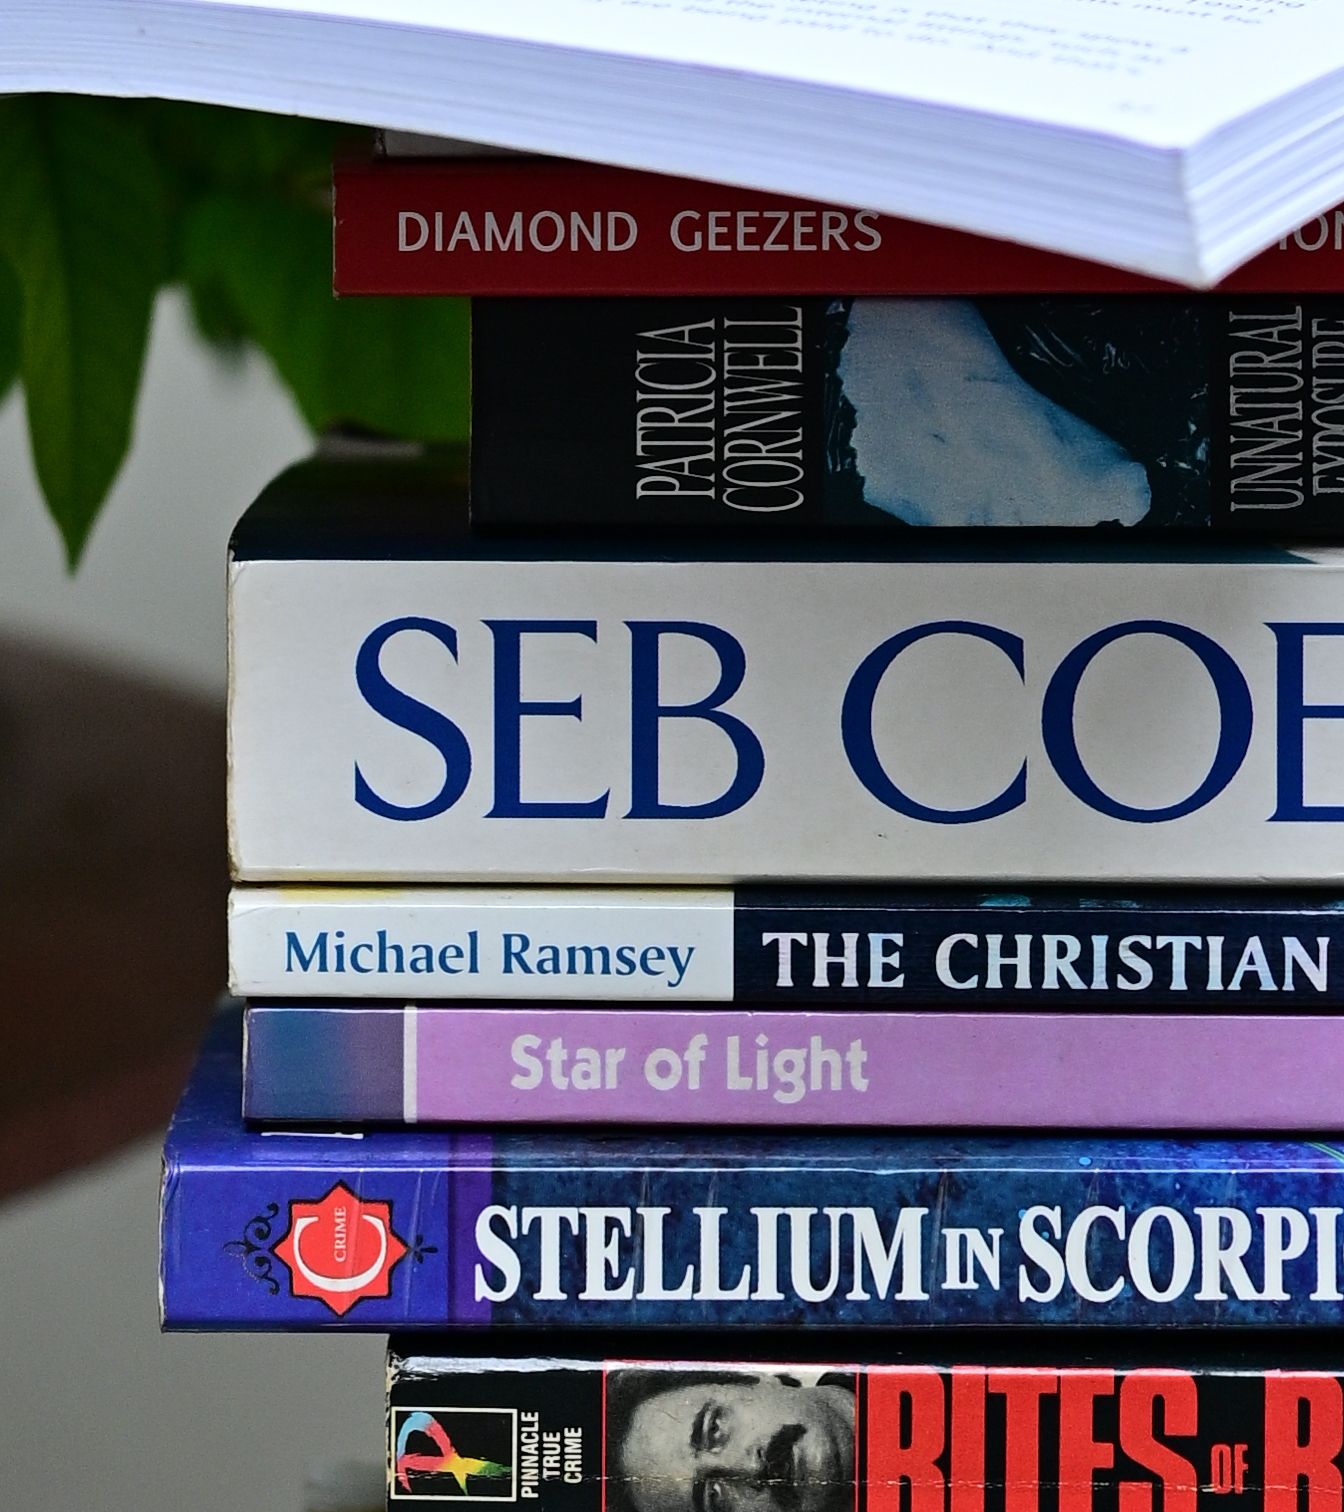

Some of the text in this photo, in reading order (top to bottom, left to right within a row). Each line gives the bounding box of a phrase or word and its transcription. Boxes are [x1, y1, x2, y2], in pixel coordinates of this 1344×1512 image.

[397, 209, 882, 252] DIAMOND GEEZERS
[635, 318, 716, 500] PATRICIA
[722, 306, 805, 513] CORNWELL
[1229, 305, 1304, 512] UNNATURAL
[354, 616, 765, 822] SEB
[284, 928, 696, 988] Michael Ramsey
[762, 932, 906, 989] THE
[935, 932, 1331, 993] CHRISTIAN
[509, 1032, 870, 1104] Star of Light
[333, 1206, 346, 1263] CRIME
[472, 1204, 930, 1303] STELLIUM
[942, 1228, 1002, 1290] IN
[520, 1411, 540, 1499] PINNACLE
[542, 1431, 562, 1481] TRUE
[564, 1427, 583, 1485] CRIME
[1210, 1443, 1249, 1495] OF
